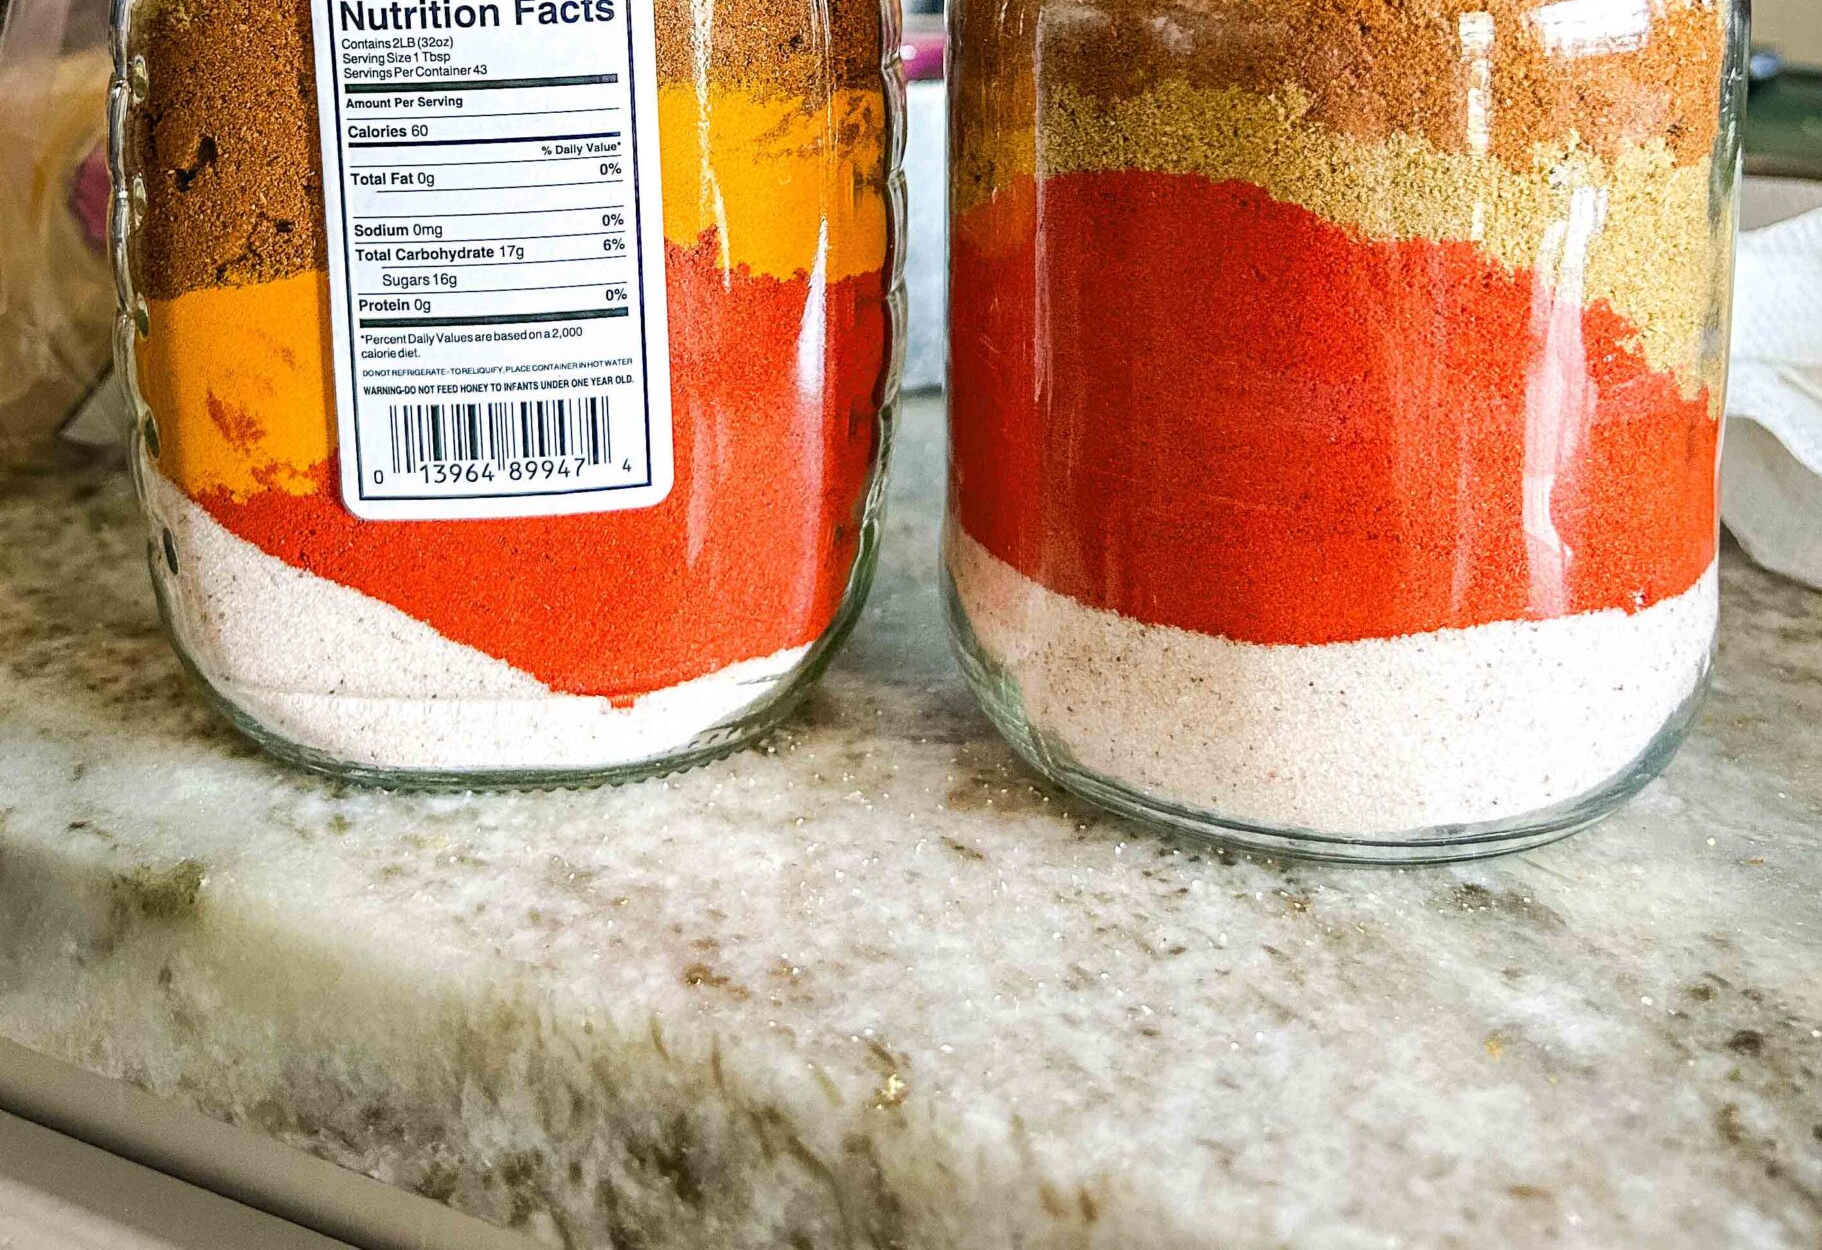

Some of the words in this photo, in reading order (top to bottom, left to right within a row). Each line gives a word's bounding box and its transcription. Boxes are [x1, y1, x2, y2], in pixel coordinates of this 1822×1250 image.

[341, 38, 391, 50] Contains
[392, 37, 416, 49] 2LB
[417, 36, 454, 50] (32oz)
[343, 53, 385, 66] Serving
[386, 52, 411, 63] Size
[413, 52, 419, 63] 1
[421, 51, 451, 64] Tbsp
[344, 67, 393, 81] Servings
[394, 67, 414, 78] Per
[415, 65, 472, 77] Container
[473, 65, 488, 75] 43
[346, 98, 391, 109] Amount
[394, 97, 414, 108] Per
[417, 96, 463, 108] Serving
[348, 125, 407, 139] Calories
[411, 124, 428, 137] 60
[555, 144, 583, 156] Daily
[600, 162, 622, 175] 0%
[350, 172, 386, 186] Total
[391, 172, 414, 185] Fat
[417, 172, 435, 187] 0g
[602, 213, 624, 227] 0%
[354, 223, 409, 237] Sodium
[413, 223, 443, 238] 0mg
[603, 238, 625, 251] 6%
[355, 248, 391, 262] Total
[395, 246, 494, 263] Carbohydrate
[499, 245, 524, 260] 17g
[382, 274, 430, 289] Sugars
[433, 273, 457, 288] 16g
[605, 288, 627, 301] 0%
[359, 298, 410, 312] Protein
[414, 298, 431, 314] 0g
[408, 333, 435, 346] Daily
[436, 333, 474, 343] Values
[474, 333, 492, 342] are
[494, 330, 527, 341] based
[528, 331, 542, 340] on
[544, 331, 551, 339] a
[552, 326, 583, 339] 2,000
[361, 349, 396, 359] calorie
[398, 348, 421, 358] diet.
[375, 369, 390, 377] NOT
[392, 368, 445, 376] REFRIGERATE
[505, 365, 531, 373] PLACE
[532, 362, 578, 372] CONTAINER
[587, 360, 603, 368] HOT
[604, 358, 633, 366] WATER
[418, 385, 435, 394] NOT
[437, 384, 458, 394] FEED
[460, 383, 489, 393] HONEY
[504, 381, 539, 391] INFANTS
[540, 379, 570, 390] UNDER
[571, 378, 589, 388] ONE
[591, 376, 613, 386] YEAR
[374, 470, 384, 485] 0
[419, 461, 495, 484] 13964
[508, 457, 586, 481] 89947
[622, 458, 632, 472] 4
